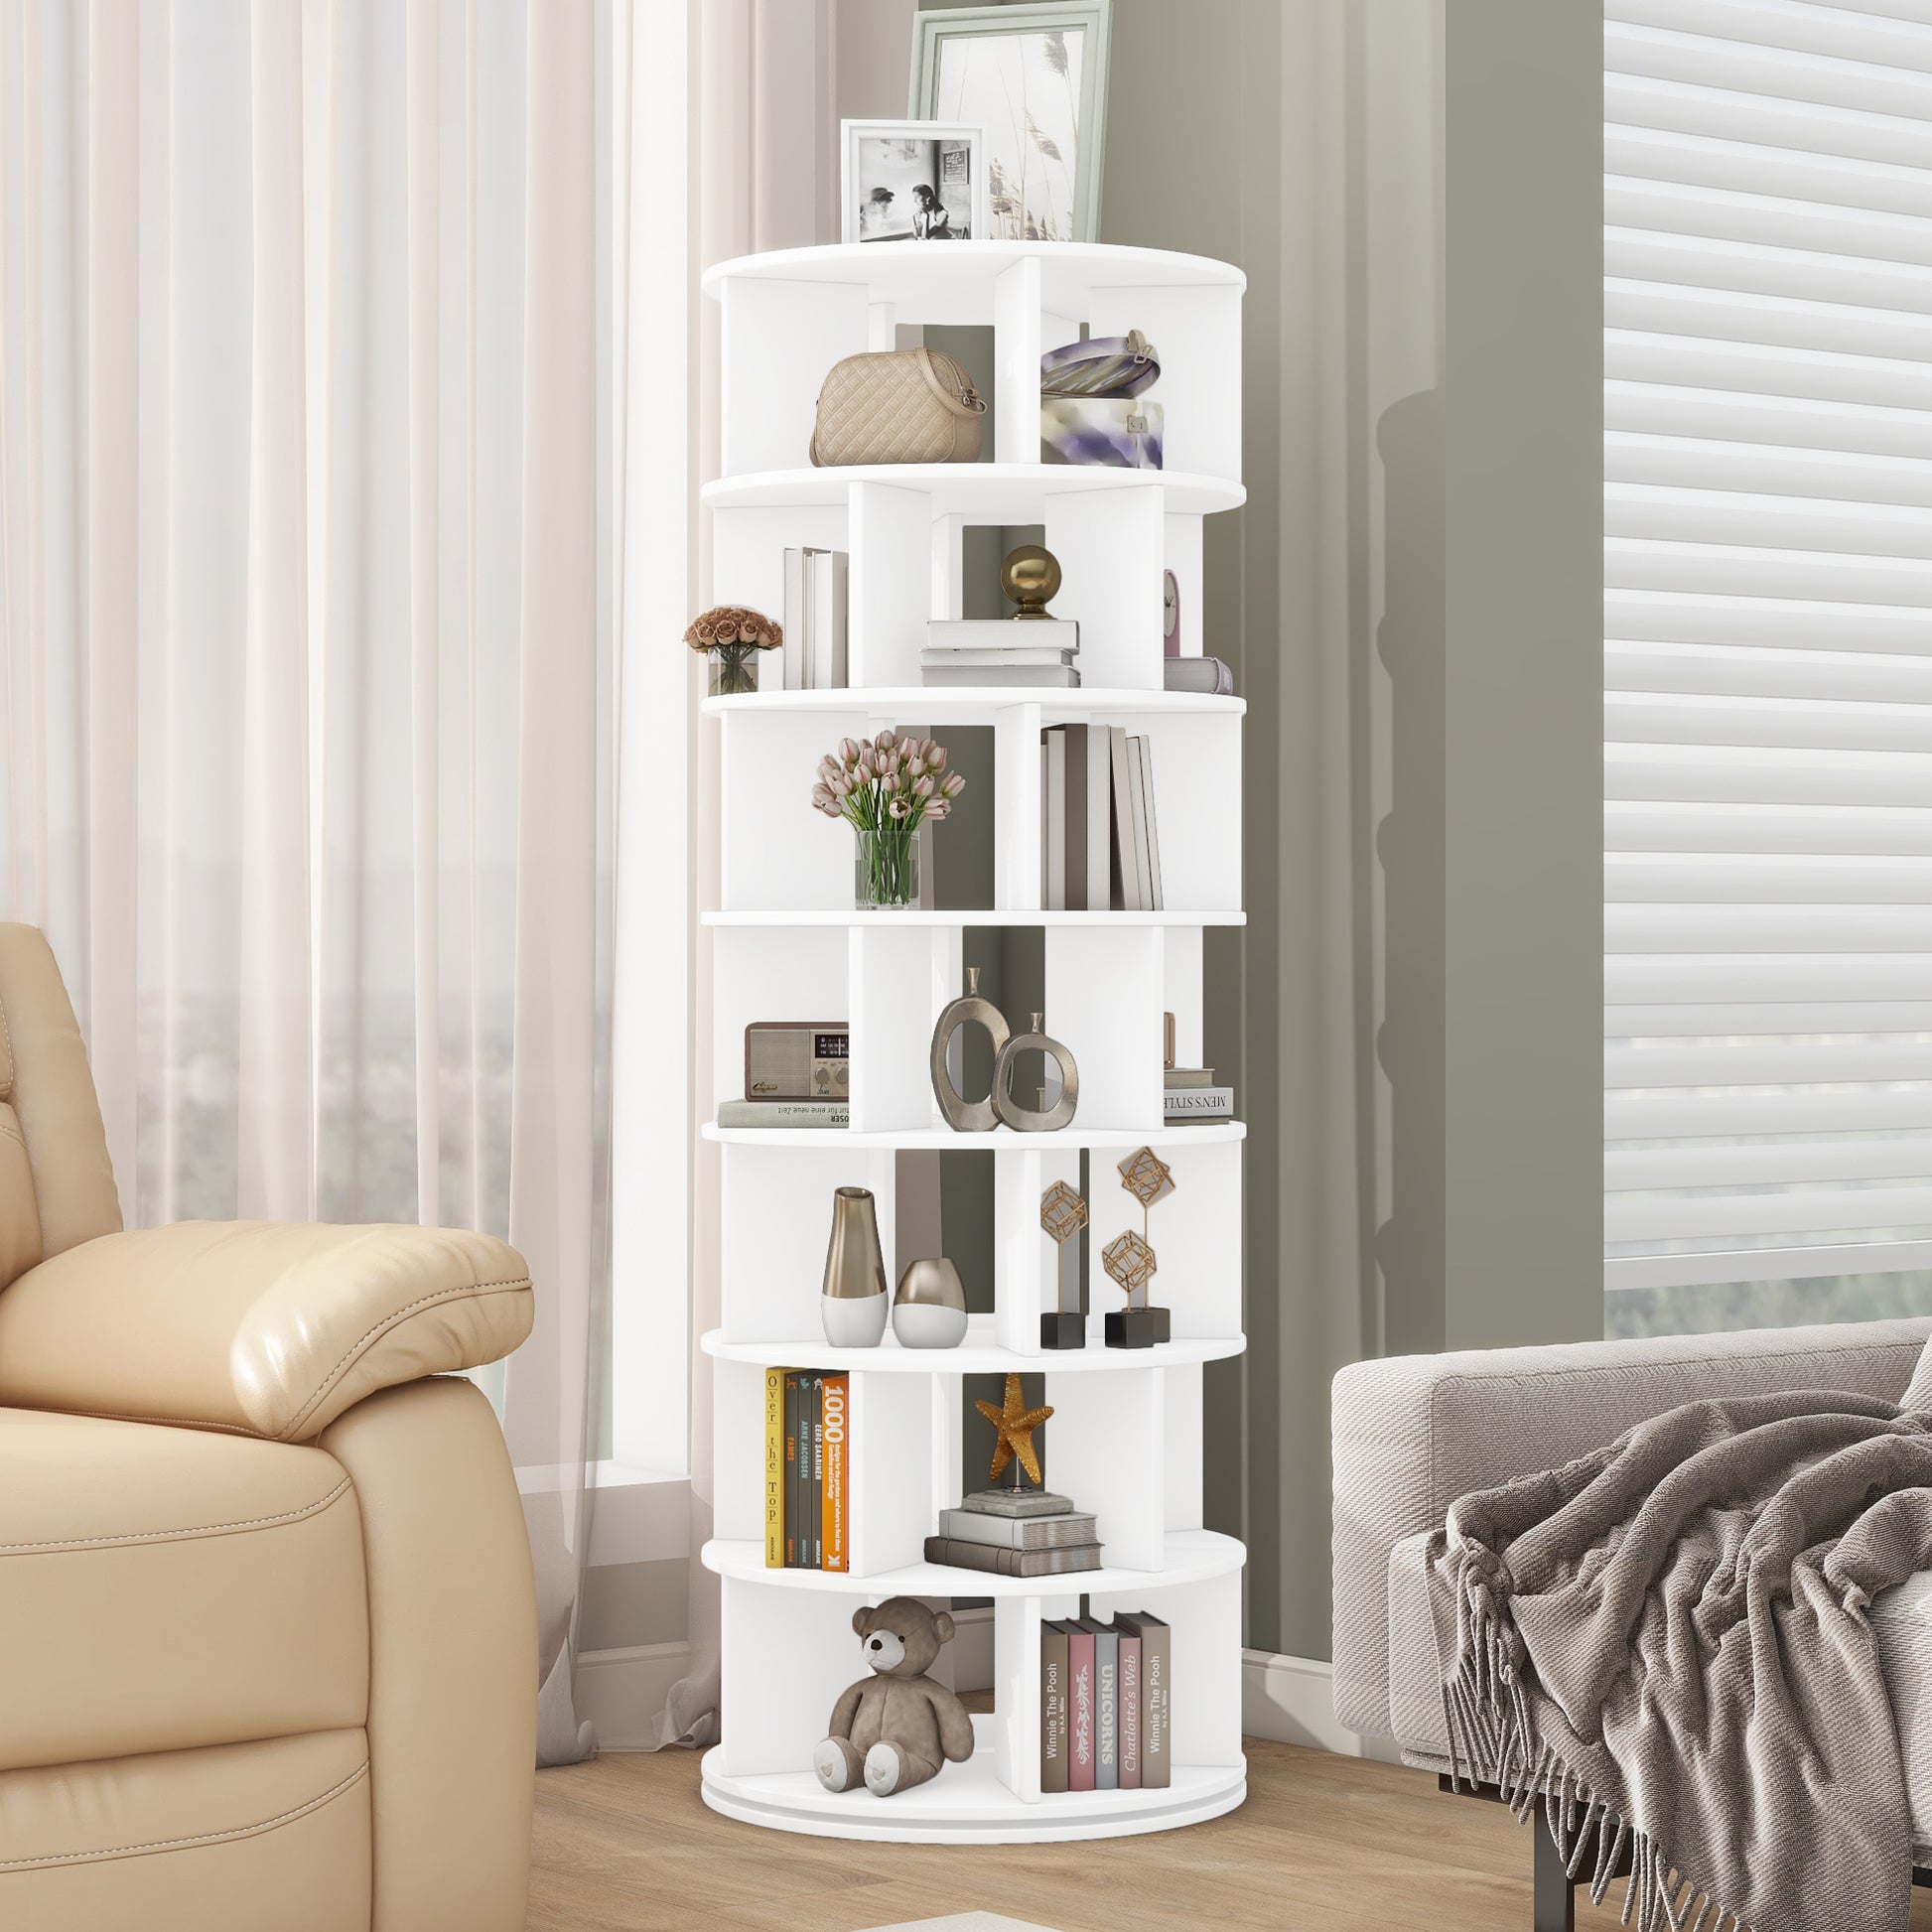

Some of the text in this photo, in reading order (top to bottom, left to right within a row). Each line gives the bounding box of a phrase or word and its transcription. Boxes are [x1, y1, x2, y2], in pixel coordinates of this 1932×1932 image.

[1194, 1095, 1226, 1107] MEN'S
[767, 1376, 777, 1422] Over
[824, 1386, 844, 1443] 1000
[768, 1482, 777, 1521] Top
[1124, 1655, 1137, 1687] Web
[1046, 1663, 1057, 1759] Winnie The Pooh
[1101, 1664, 1114, 1765] UNICORNS
[1150, 1655, 1161, 1754] Winnie The Pooh
